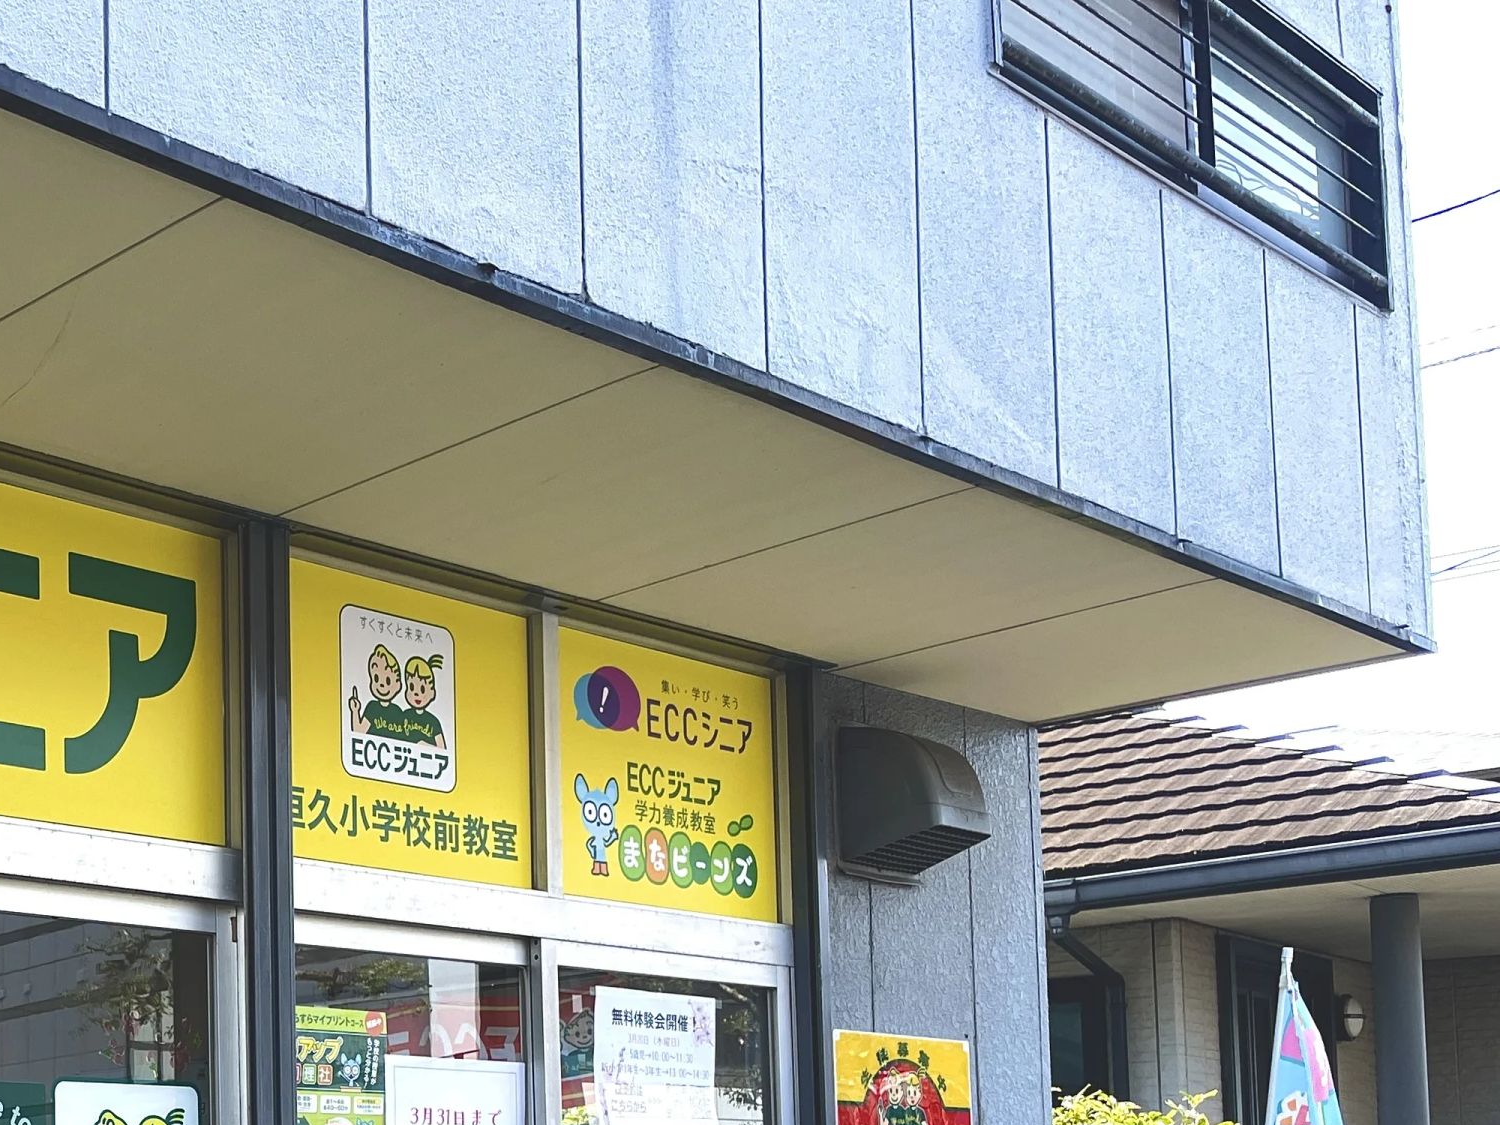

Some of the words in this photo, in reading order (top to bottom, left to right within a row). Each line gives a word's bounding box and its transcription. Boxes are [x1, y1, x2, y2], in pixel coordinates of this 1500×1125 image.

[359, 615, 434, 645] すくすくと未来へ
[646, 699, 753, 756] ECCシニア
[351, 739, 449, 780] ECCジュニア
[627, 761, 721, 806] ECCジュニア
[635, 800, 717, 835] 学力養成教室
[623, 833, 754, 888] まなビーンズ
